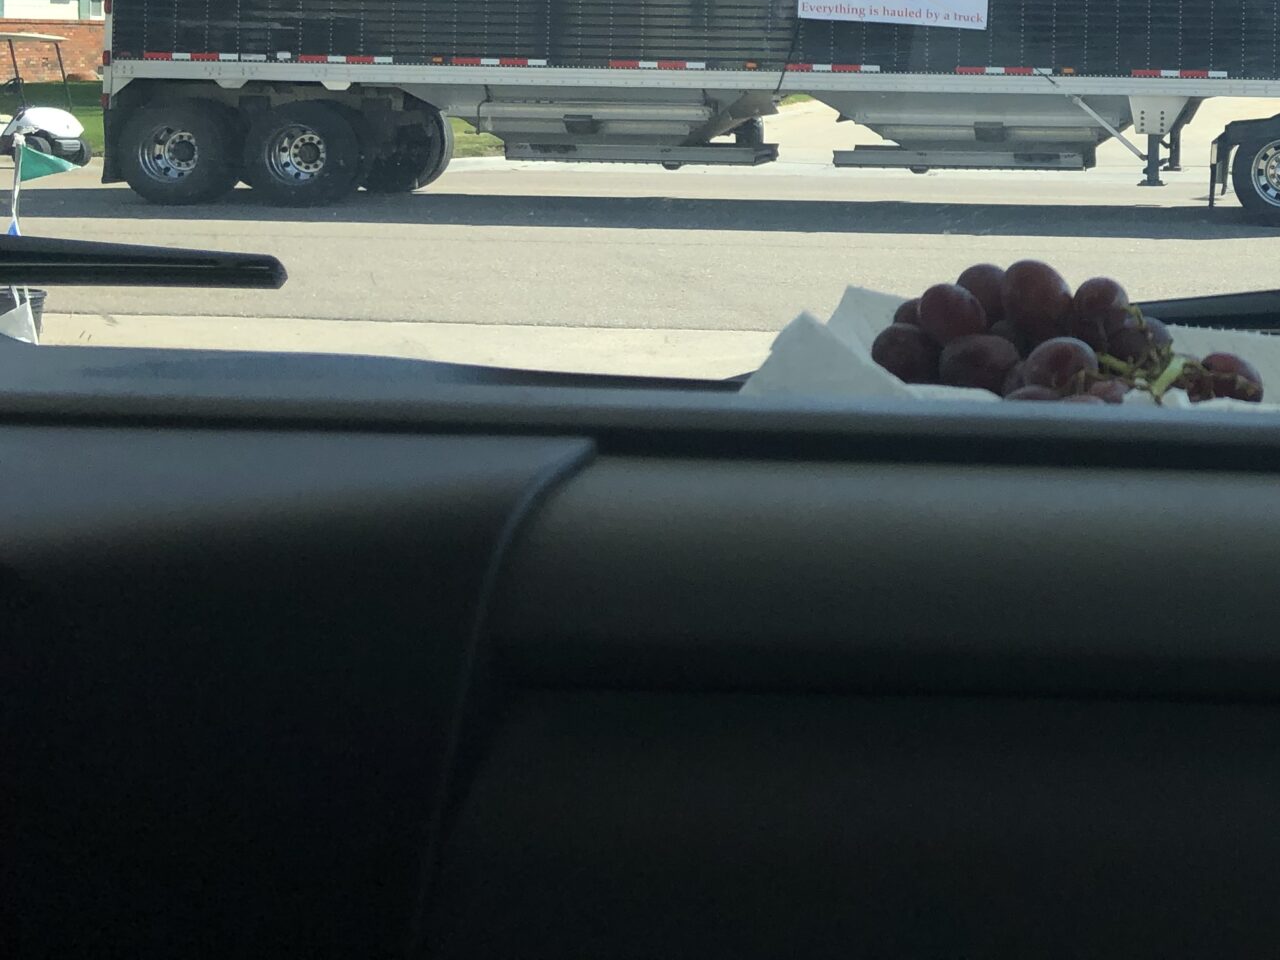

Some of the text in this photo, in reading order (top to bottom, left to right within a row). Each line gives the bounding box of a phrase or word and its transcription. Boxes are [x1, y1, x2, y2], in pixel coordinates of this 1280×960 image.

[801, 2, 984, 23] Everything is hauled by a truck
